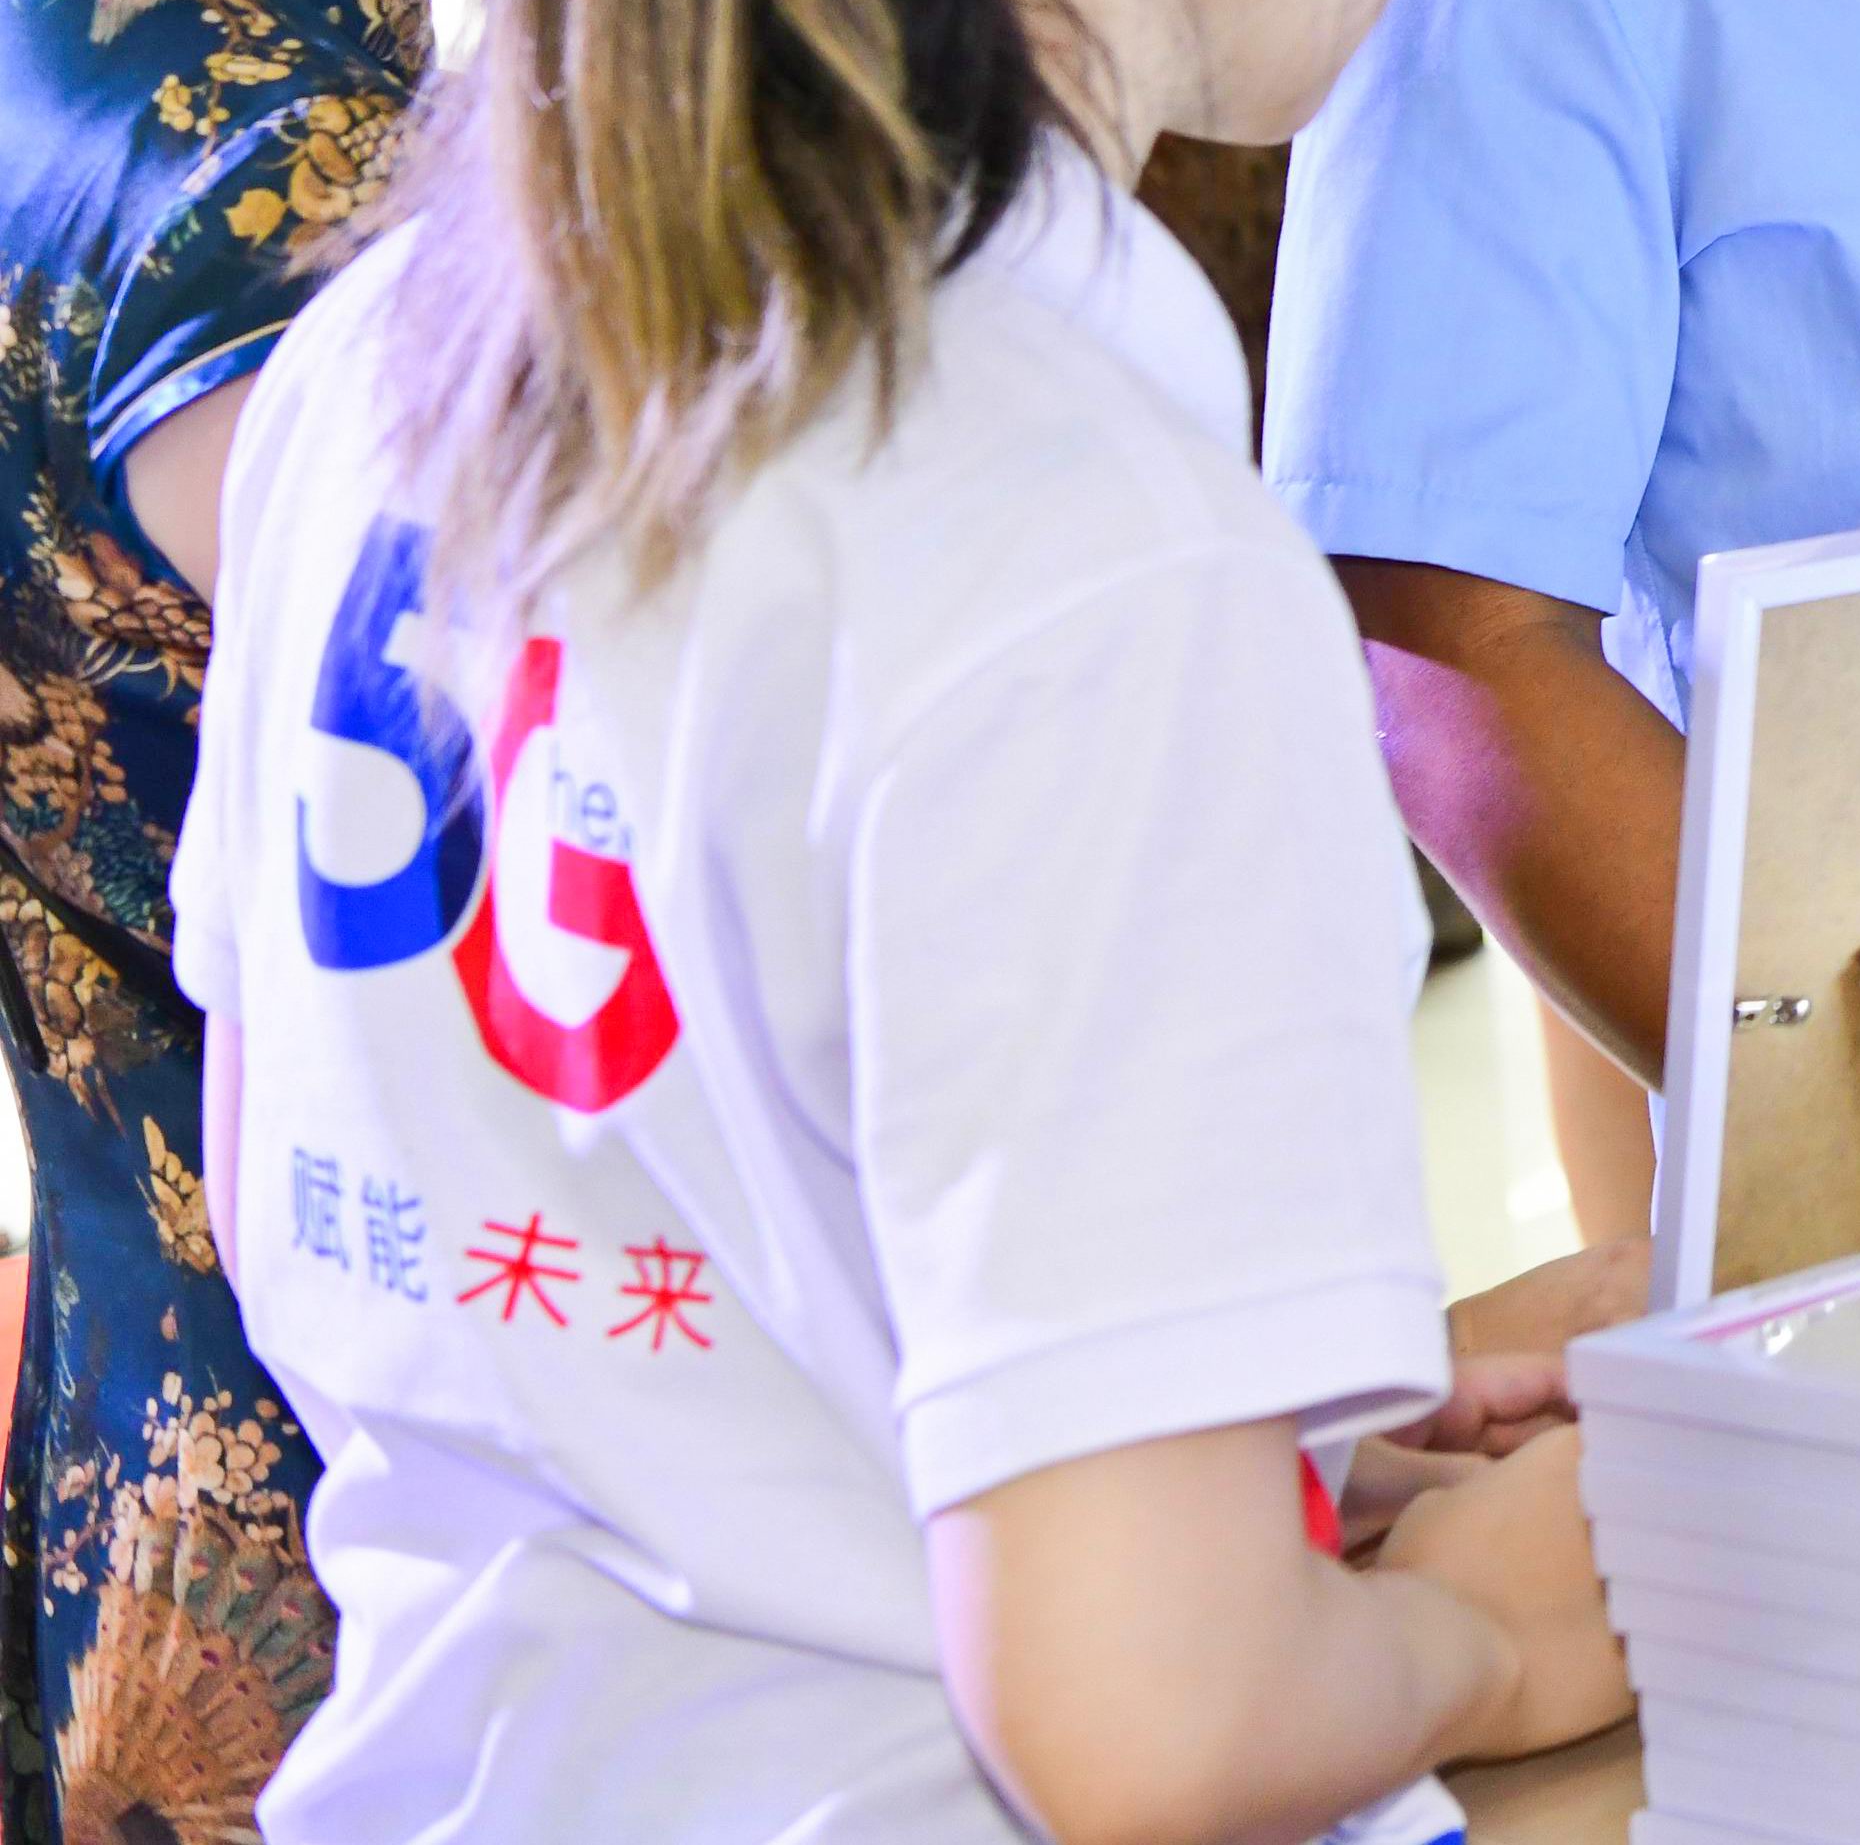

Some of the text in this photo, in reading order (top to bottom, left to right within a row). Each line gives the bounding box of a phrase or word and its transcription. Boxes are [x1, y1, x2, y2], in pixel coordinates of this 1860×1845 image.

[295, 512, 681, 1115] 5G
[290, 1145, 714, 1353] 赋能未来
